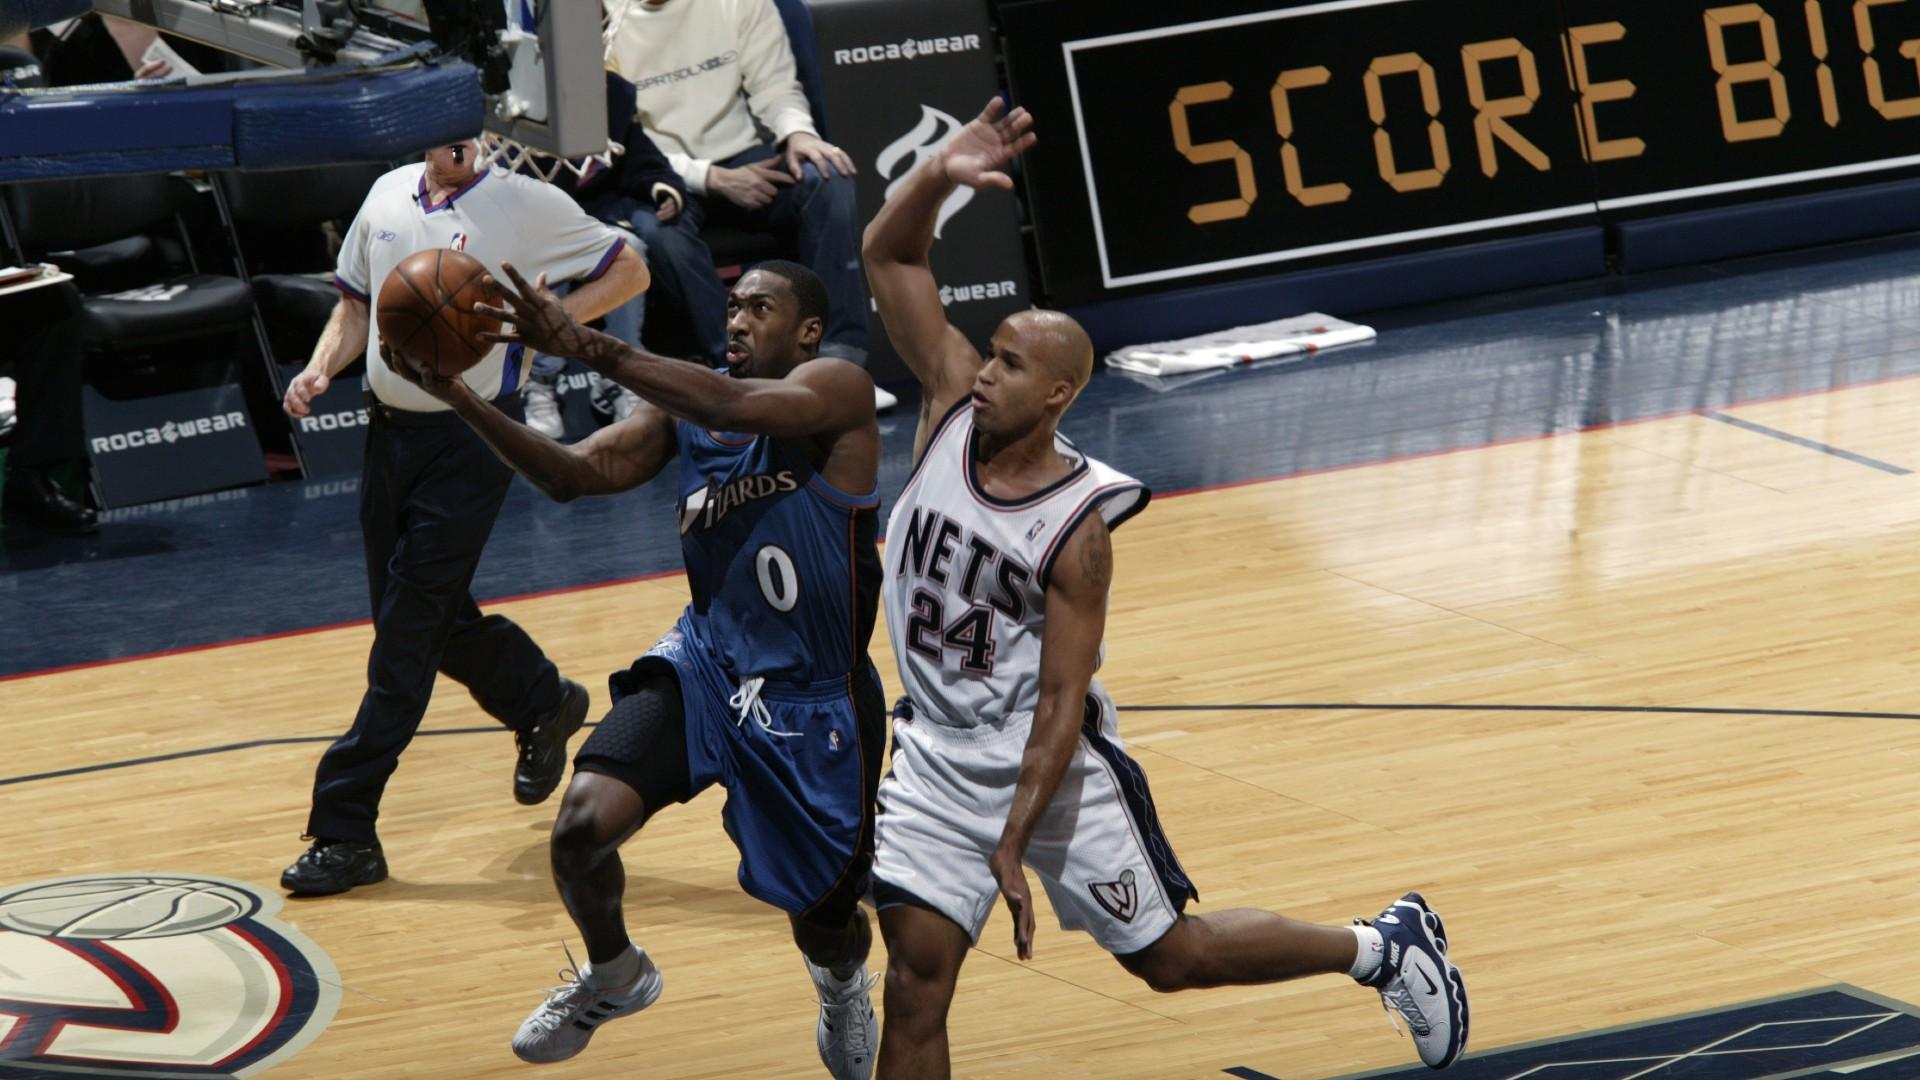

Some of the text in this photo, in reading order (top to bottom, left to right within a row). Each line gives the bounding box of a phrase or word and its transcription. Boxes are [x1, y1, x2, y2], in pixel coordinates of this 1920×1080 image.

[1169, 0, 1920, 224] SCORE BIG
[755, 544, 798, 612] 0
[897, 505, 1034, 625] NETS
[906, 586, 997, 677] 24
[1390, 940, 1400, 968] NIKE
